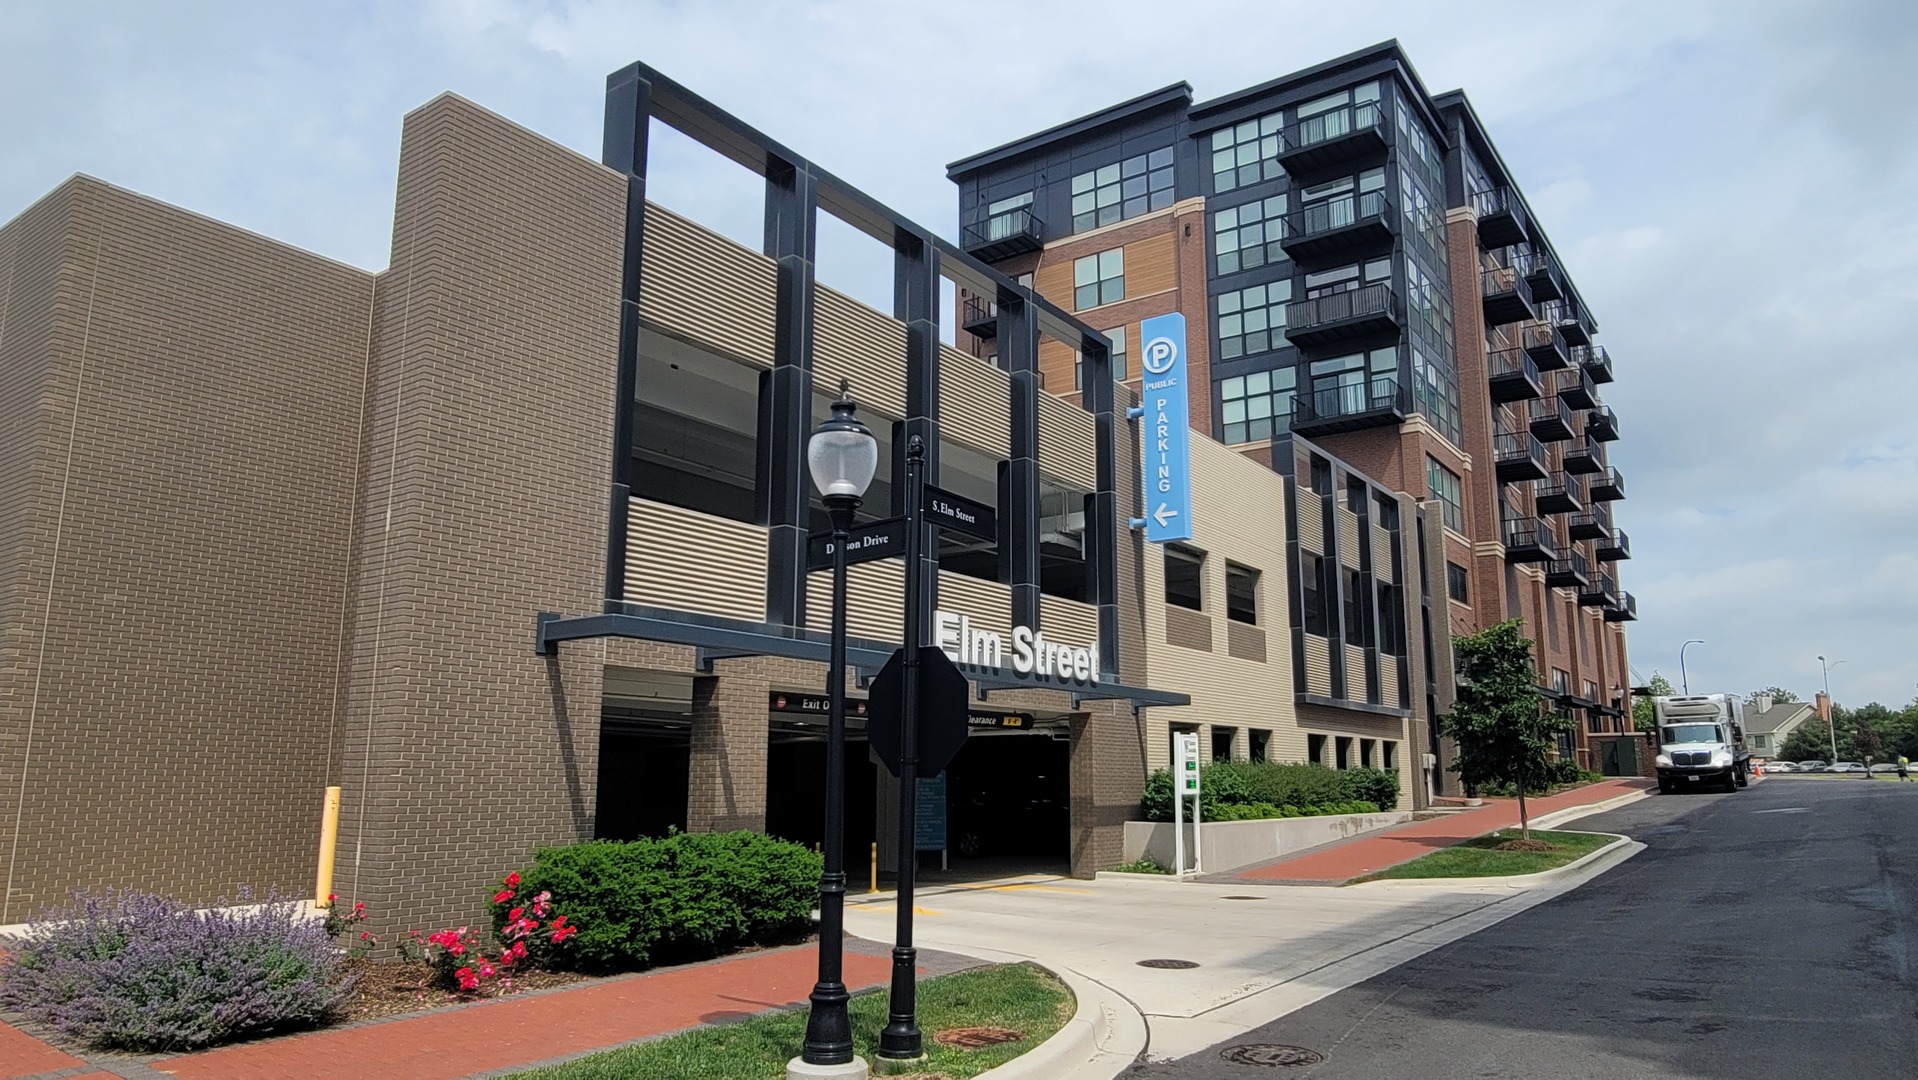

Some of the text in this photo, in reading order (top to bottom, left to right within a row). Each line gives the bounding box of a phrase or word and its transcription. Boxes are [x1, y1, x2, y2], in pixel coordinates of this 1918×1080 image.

[1152, 344, 1169, 368] P
[1145, 378, 1177, 391] PUBLIC
[1156, 398, 1171, 493] PARKING
[932, 500, 975, 524] S. Elm Street
[826, 535, 889, 555] Dson Drive
[933, 610, 1100, 683] Elm Street
[802, 699, 820, 710] Exit
[967, 714, 997, 725] learance
